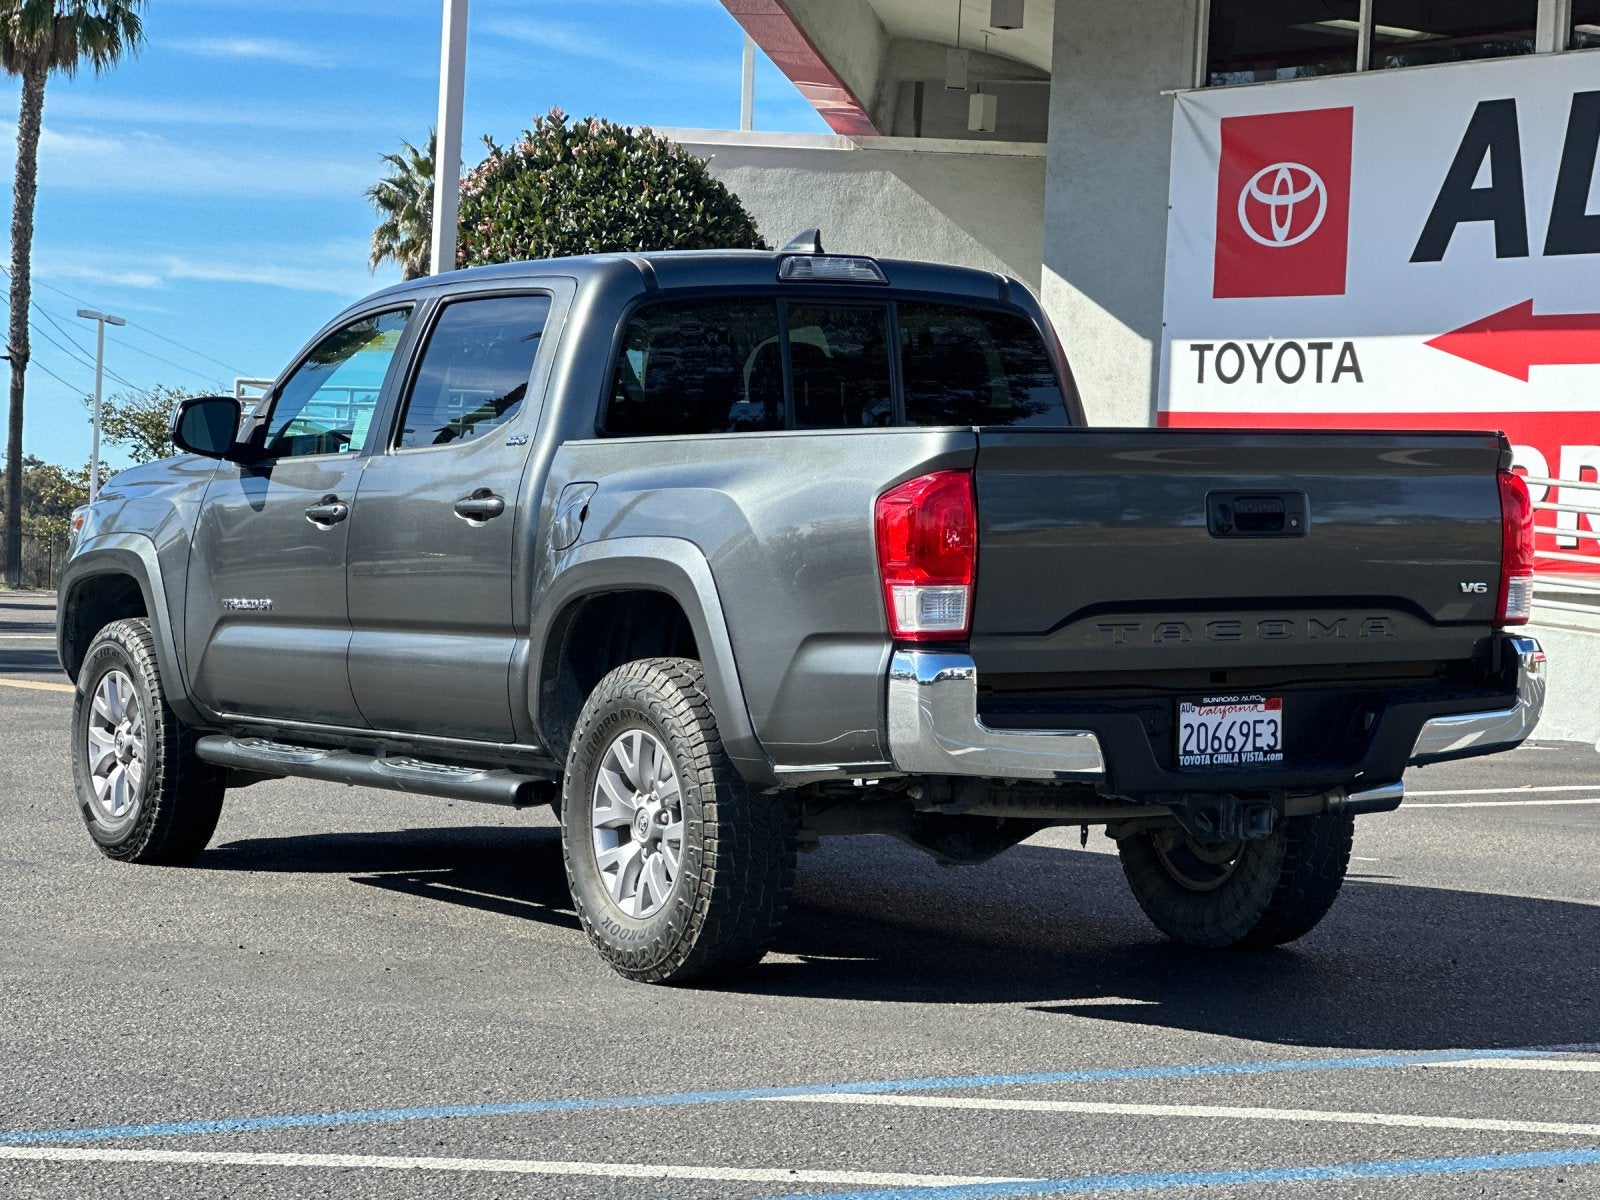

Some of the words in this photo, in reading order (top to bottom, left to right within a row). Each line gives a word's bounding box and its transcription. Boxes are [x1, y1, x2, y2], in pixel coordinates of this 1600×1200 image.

[1190, 341, 1364, 384] TOYOTA
[1461, 582, 1488, 594] V6
[1097, 616, 1395, 645] TACOMA
[1203, 696, 1239, 704] SUNROAD
[1241, 694, 1262, 702] AUTO
[1181, 703, 1195, 714] AUG
[1198, 703, 1259, 719] California
[1182, 719, 1278, 754] 20669E3
[1180, 754, 1211, 766] TOYOTA
[1212, 753, 1239, 764] CHULA
[1241, 752, 1283, 763] VISTA.com
